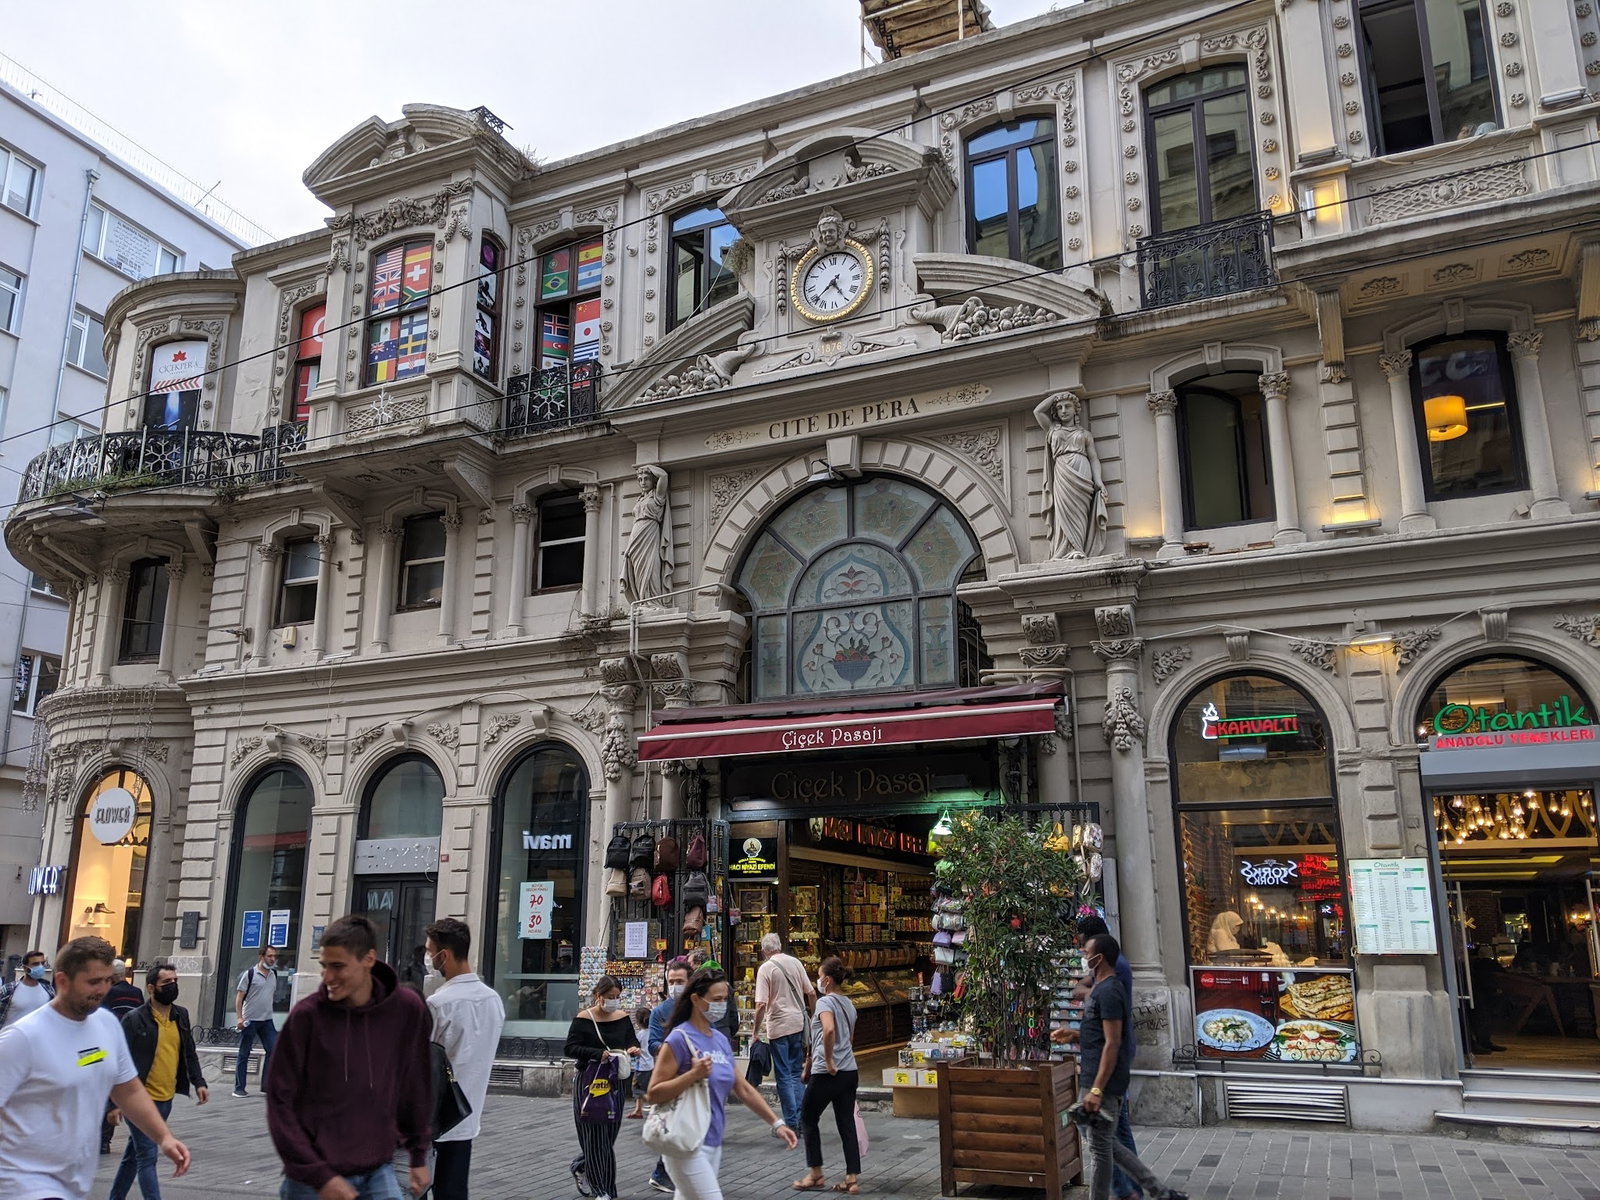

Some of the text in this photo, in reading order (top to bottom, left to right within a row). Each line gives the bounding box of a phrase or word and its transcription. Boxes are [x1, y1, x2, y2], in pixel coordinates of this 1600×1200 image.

[821, 342, 842, 354] 1876
[827, 408, 855, 430] DE
[1433, 695, 1590, 736] Otantik
[1436, 734, 1505, 749] ANADOLU
[95, 805, 131, 824] FLOWER
[529, 894, 544, 908] 70
[528, 914, 542, 929] 30
